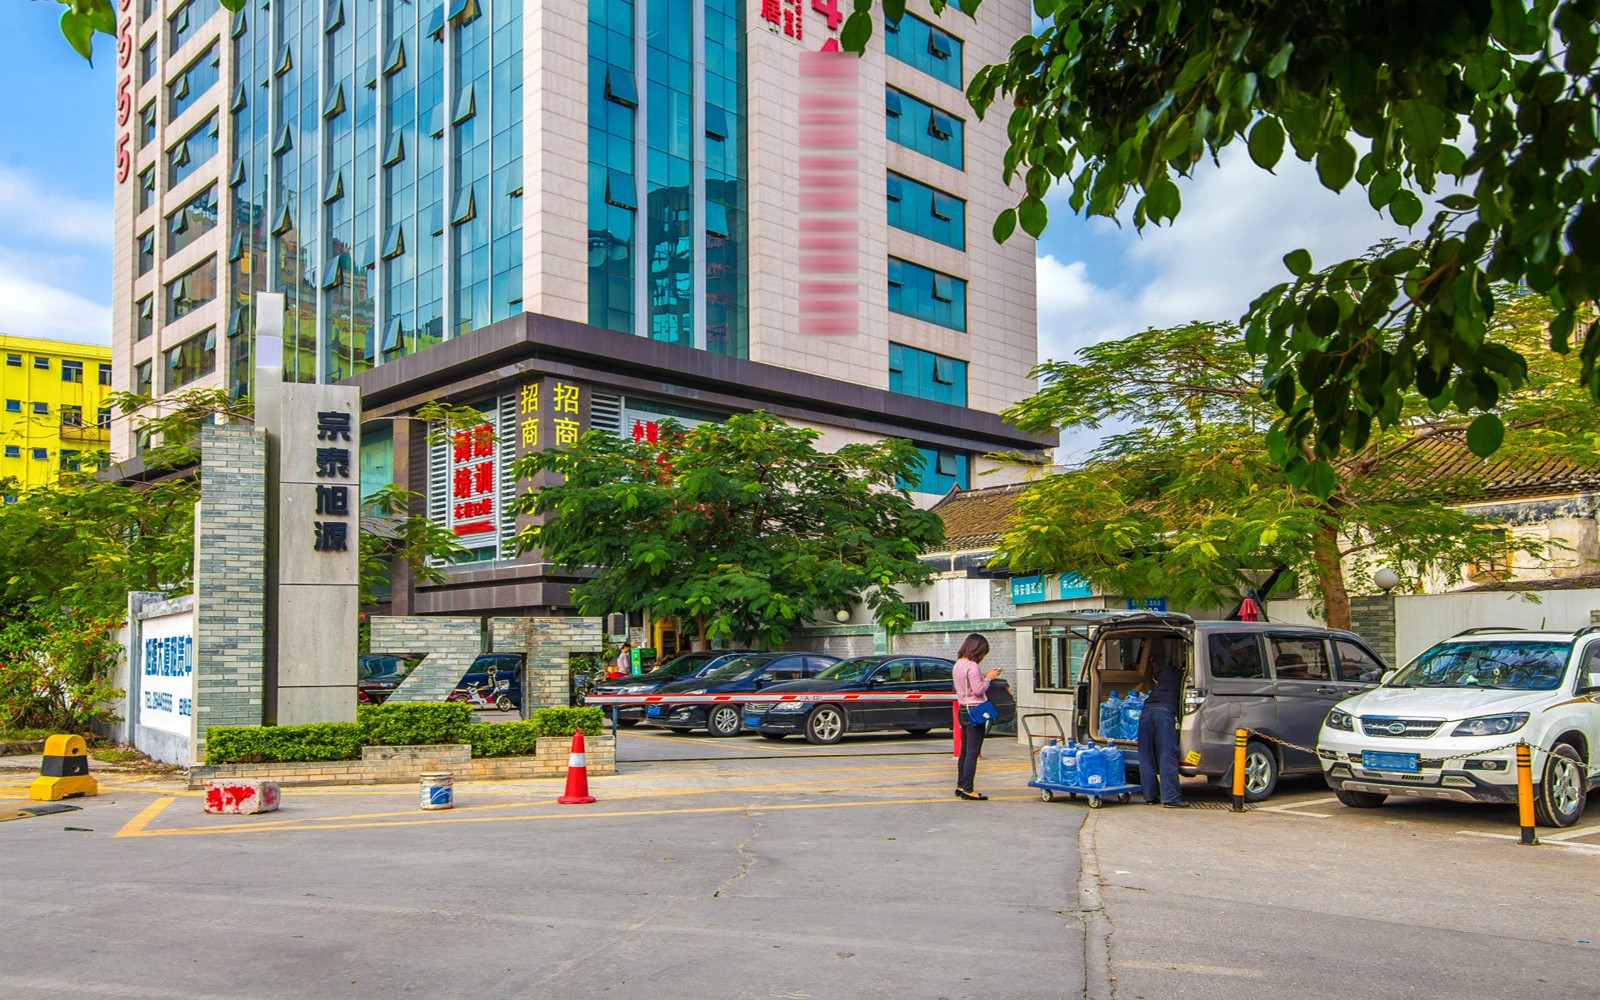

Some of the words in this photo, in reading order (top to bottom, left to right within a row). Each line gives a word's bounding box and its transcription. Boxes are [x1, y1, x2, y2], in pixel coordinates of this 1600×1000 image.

[117, 0, 132, 184] 555
[314, 411, 351, 552] 宗泰旭源
[453, 461, 493, 498] 培训
